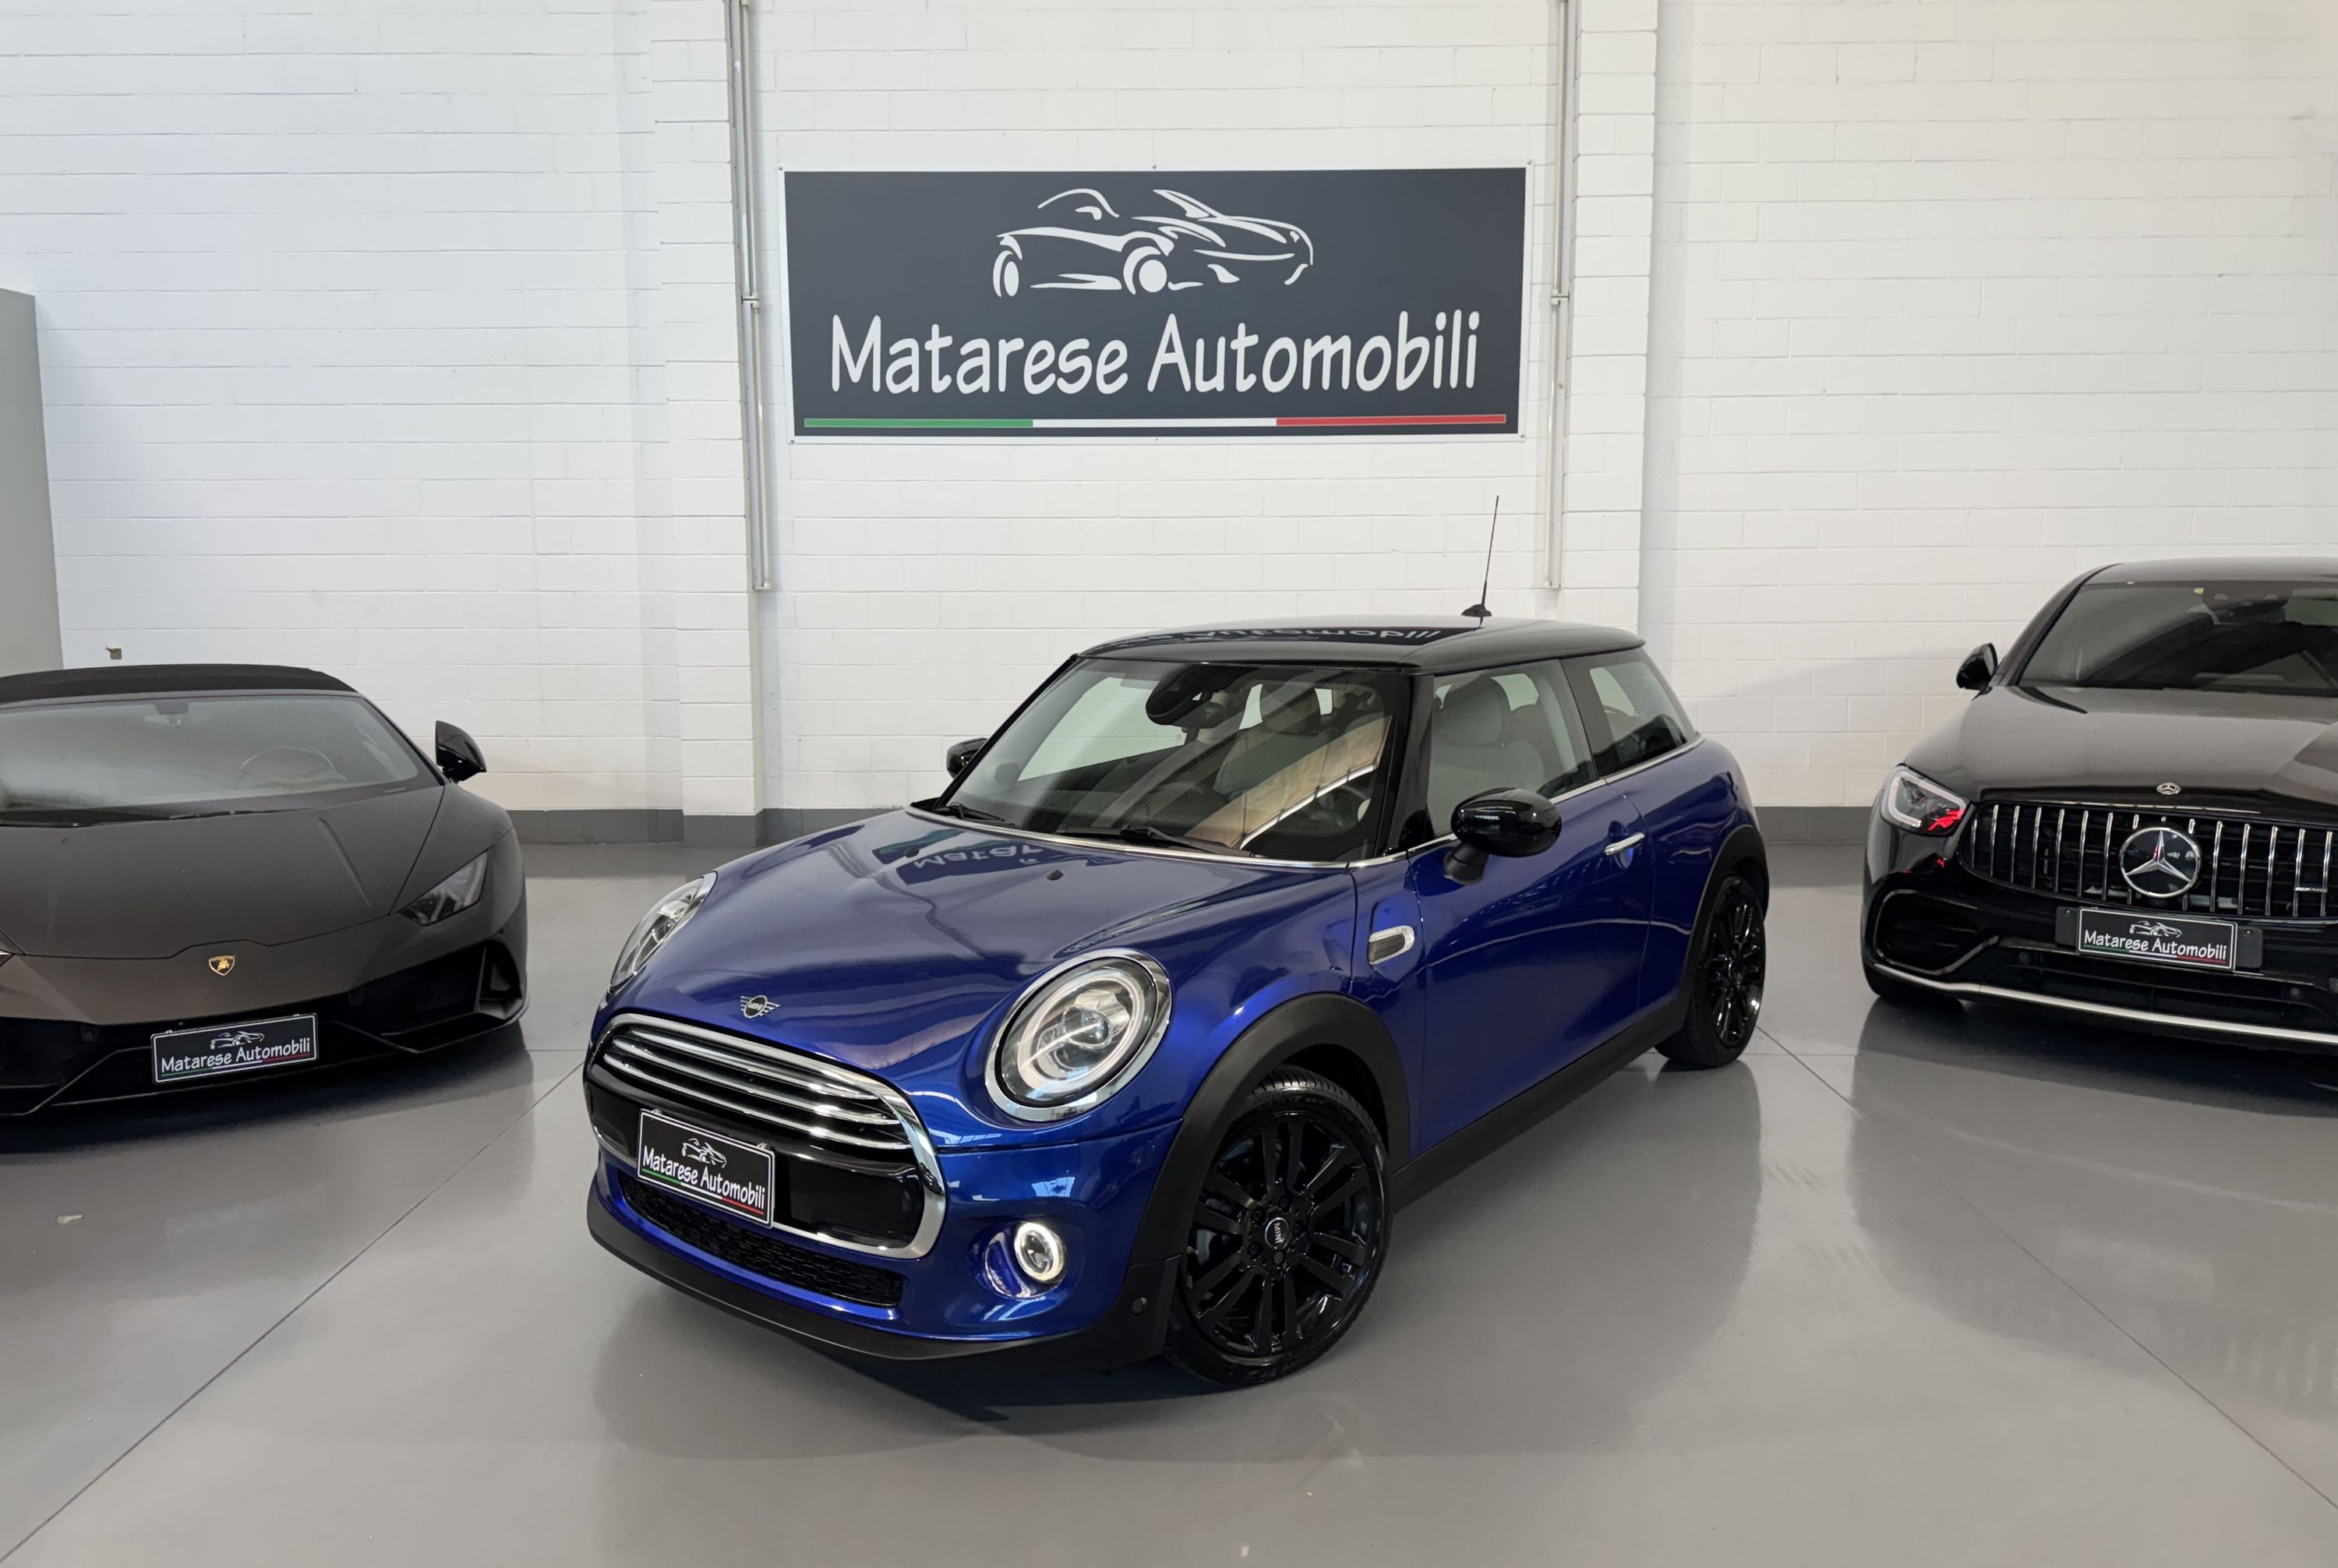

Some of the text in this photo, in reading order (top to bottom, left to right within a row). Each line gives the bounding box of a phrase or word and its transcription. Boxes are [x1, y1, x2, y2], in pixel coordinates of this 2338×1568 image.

[832, 309, 1480, 394] Matarese Automobili
[2084, 929, 2227, 960] Matarese Automobili
[161, 1038, 310, 1073] Matarese Automobili
[643, 1145, 765, 1209] Matarese Automobili
